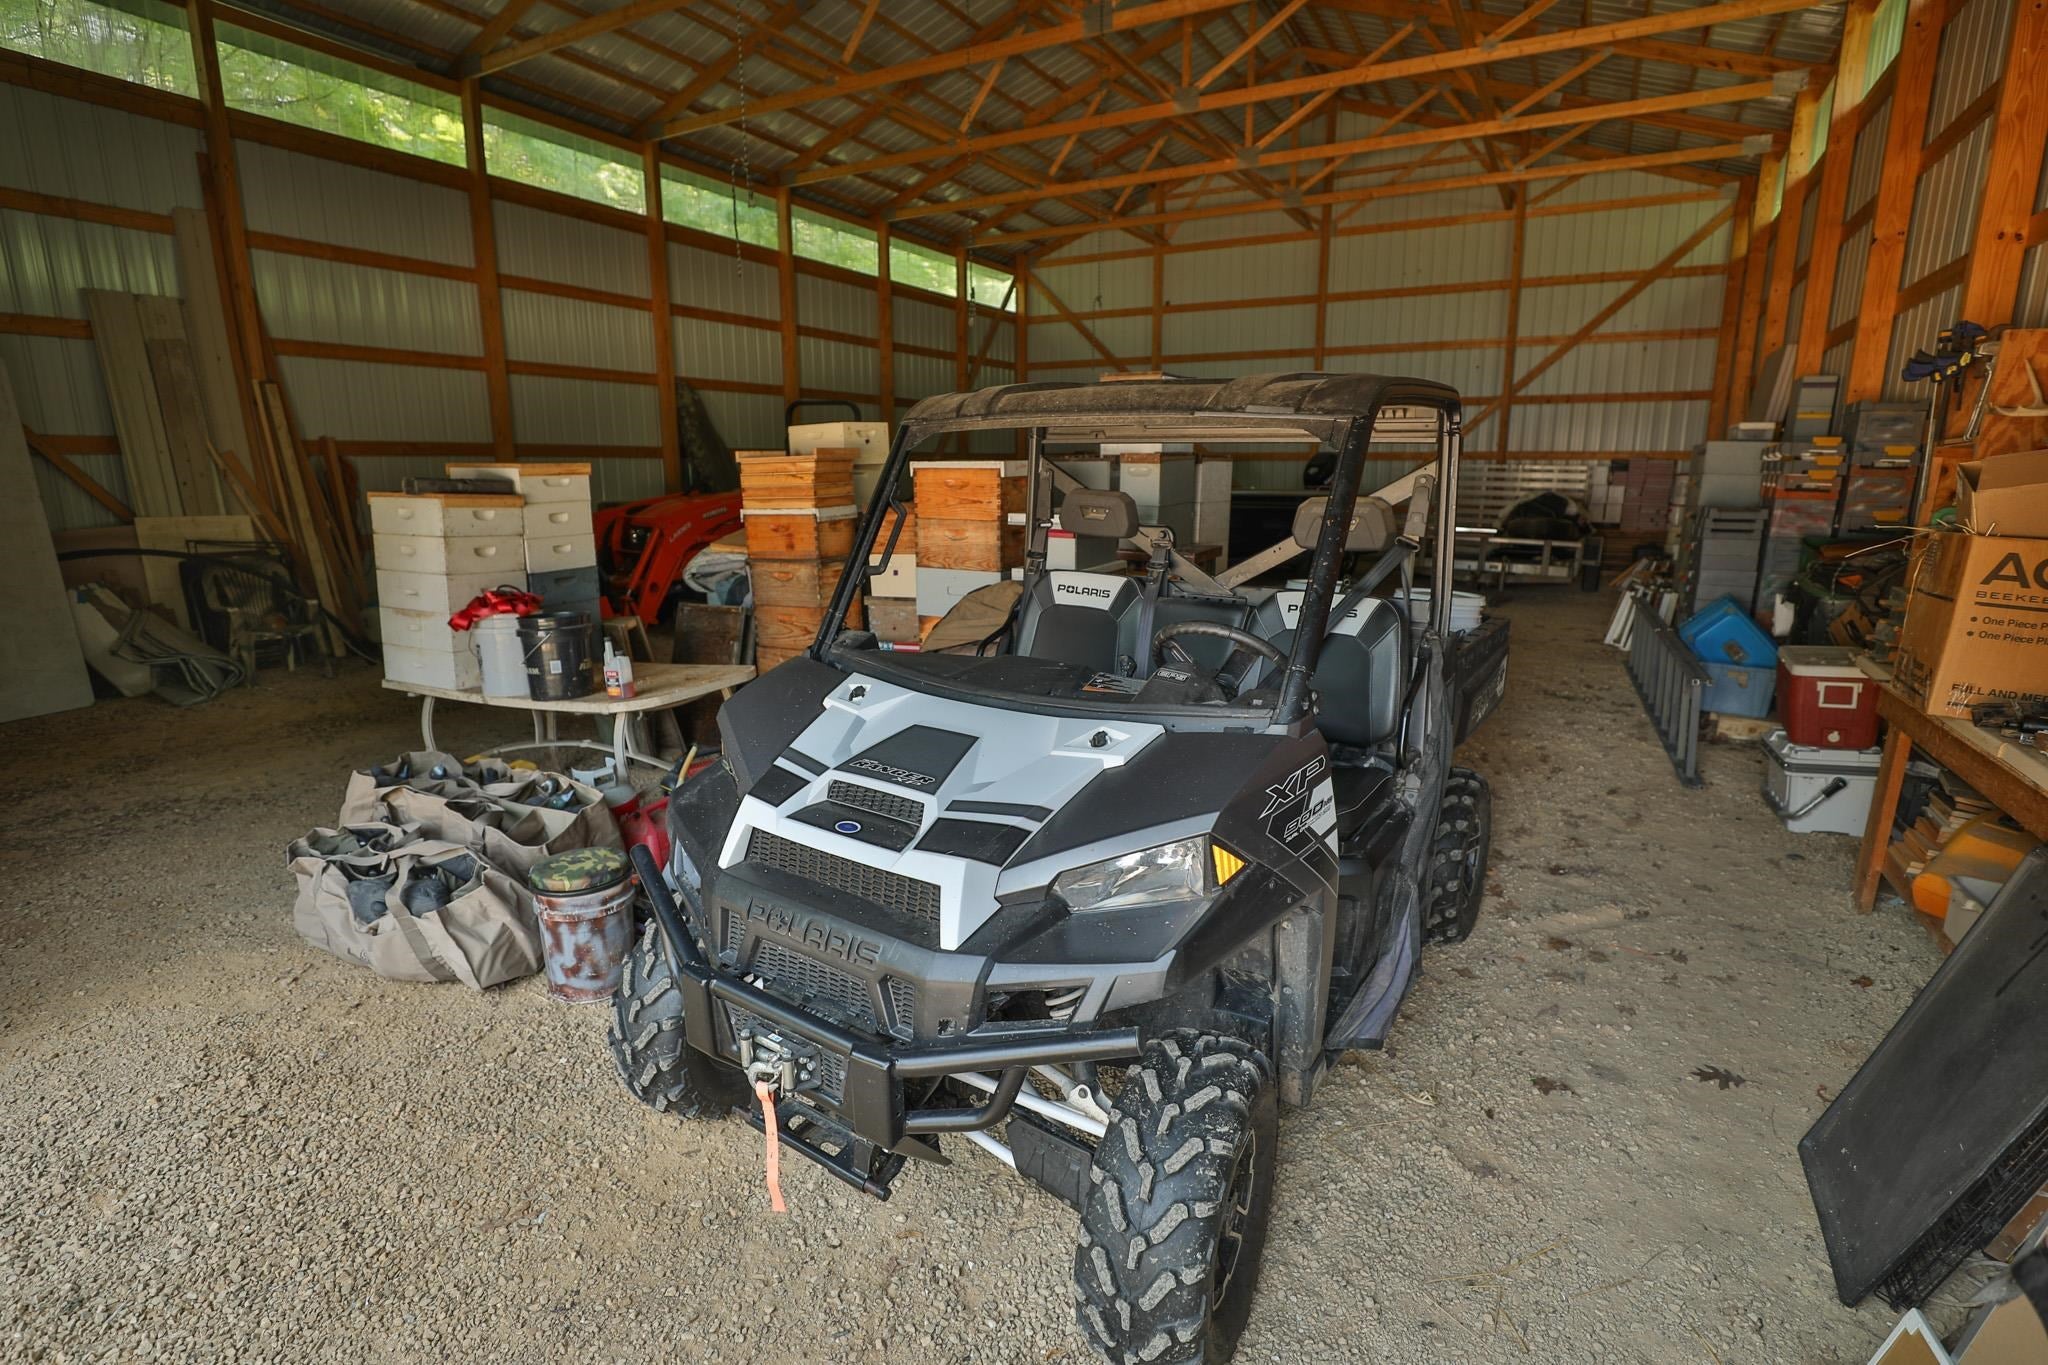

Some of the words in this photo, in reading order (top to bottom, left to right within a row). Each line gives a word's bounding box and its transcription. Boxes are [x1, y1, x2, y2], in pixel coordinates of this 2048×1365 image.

[1057, 584, 1112, 599] POLARIS
[1982, 616, 2005, 626] One
[2007, 618, 2038, 629] Piece
[1979, 630, 2001, 641] One
[2003, 633, 2034, 644] Piece
[1987, 688, 2018, 700] AND
[849, 760, 935, 785] RANGER
[1258, 755, 1326, 820] XP
[746, 897, 882, 972] POLARIS
